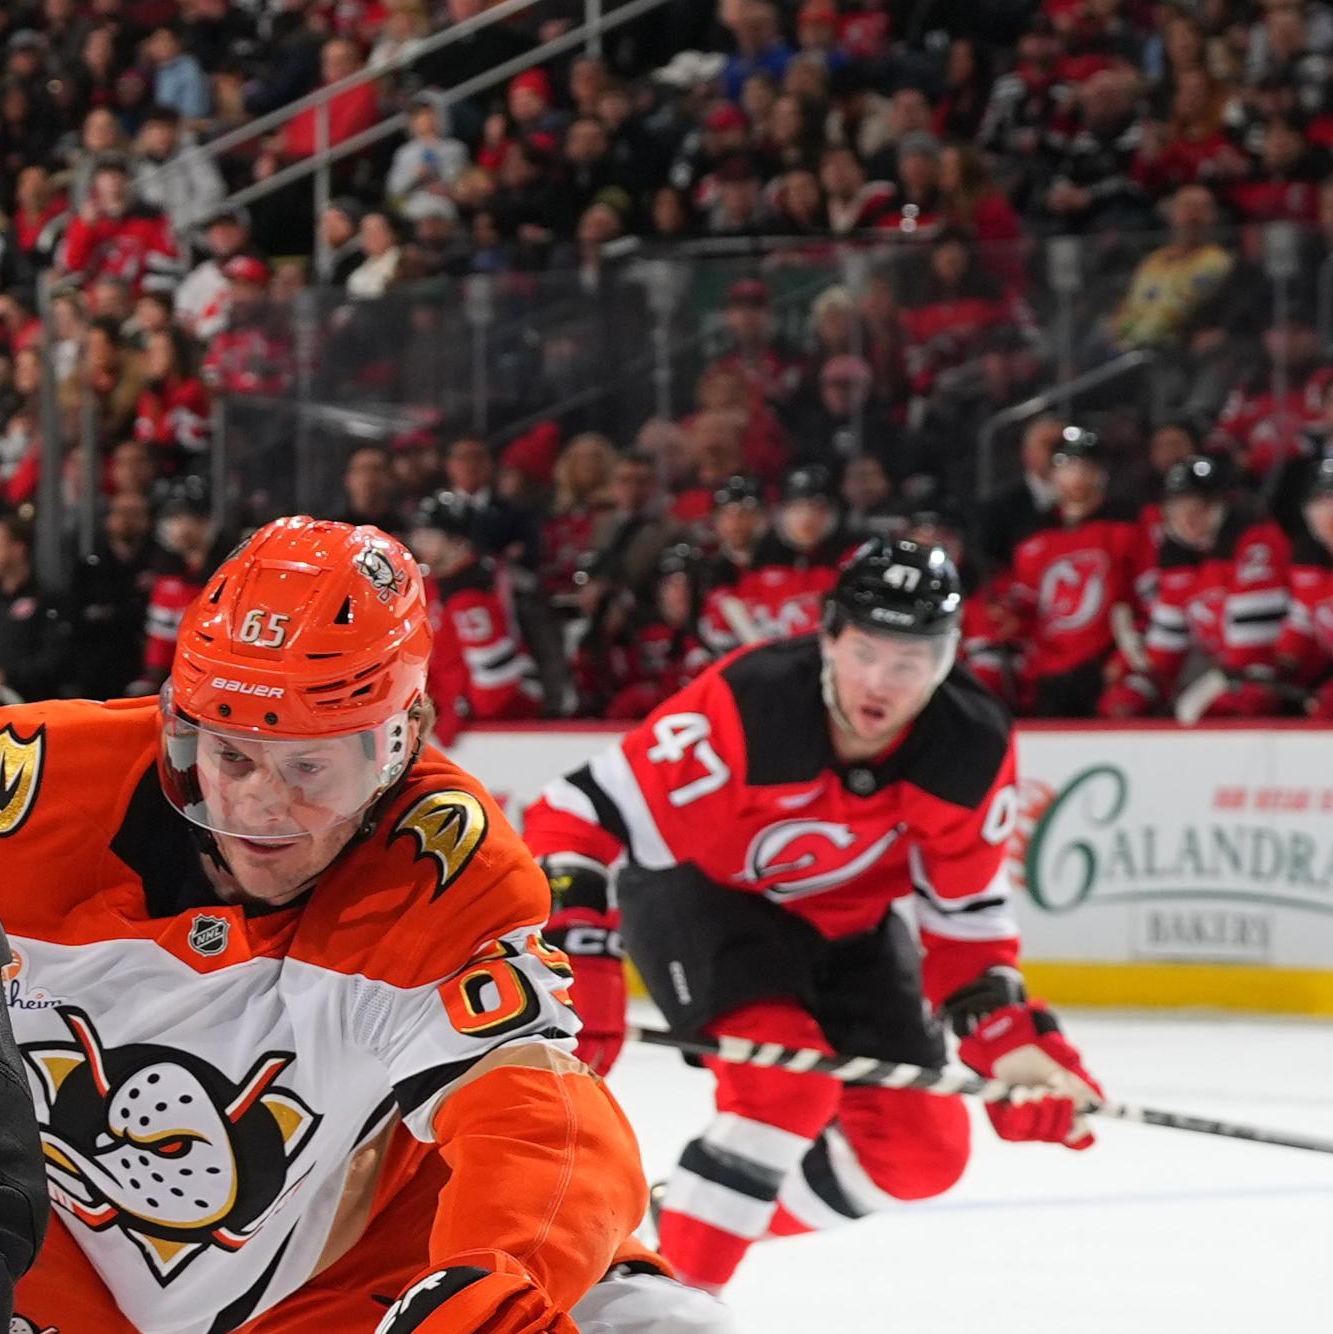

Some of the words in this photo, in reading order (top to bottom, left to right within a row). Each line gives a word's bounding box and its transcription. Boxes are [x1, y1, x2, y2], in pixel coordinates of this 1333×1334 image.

[238, 609, 290, 648] 65
[210, 677, 285, 699] BAUER
[646, 711, 731, 807] 47
[196, 927, 222, 945] NHL
[1145, 911, 1271, 948] BAKERY
